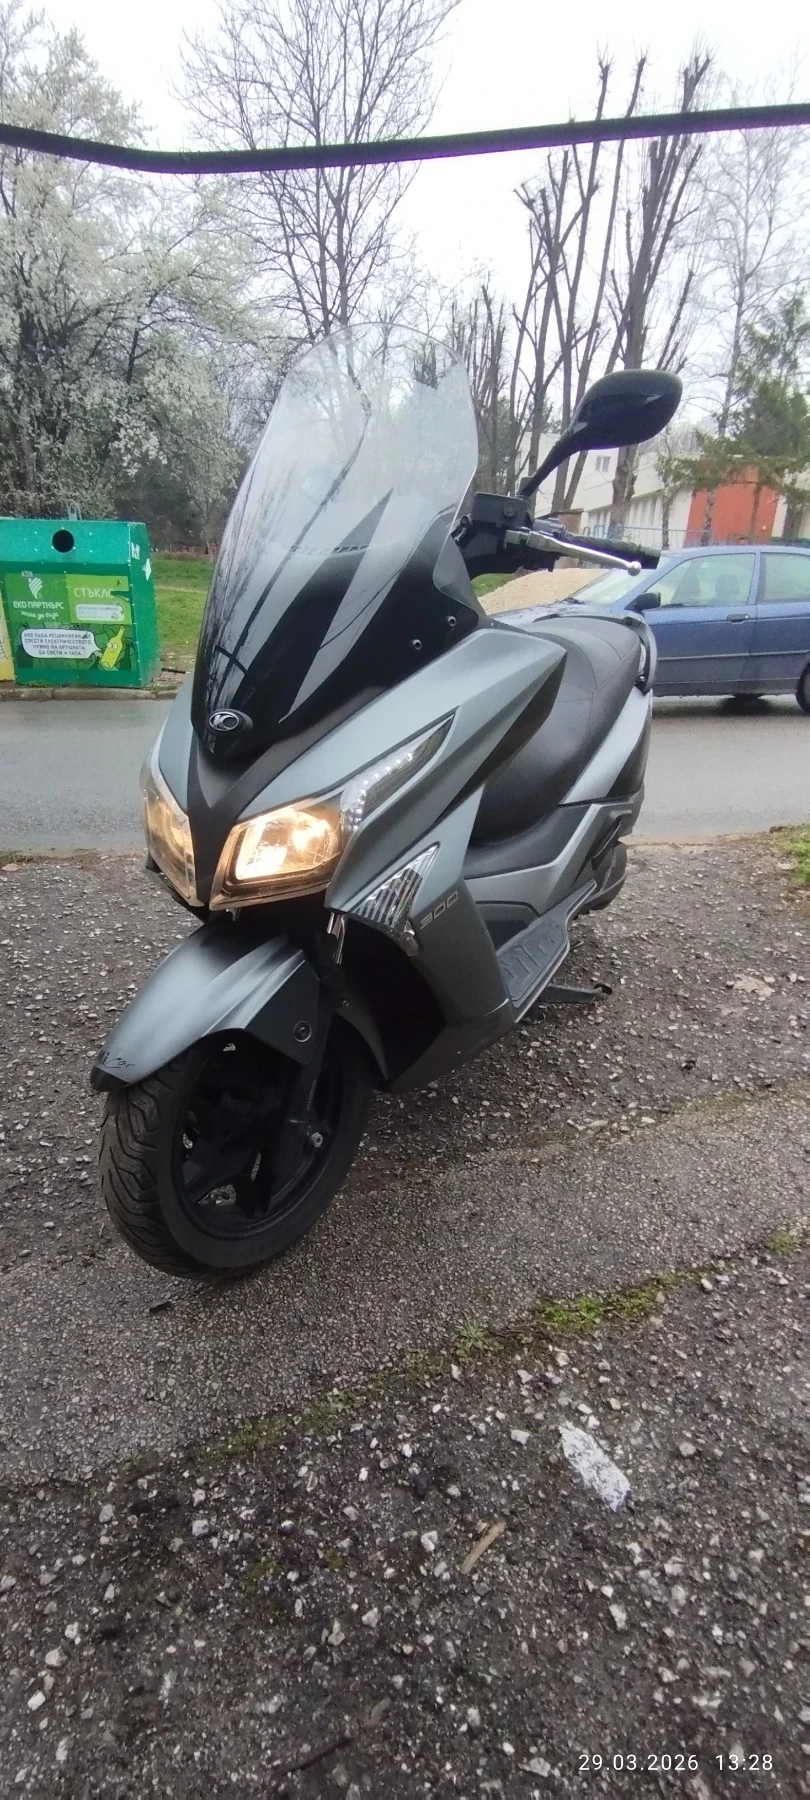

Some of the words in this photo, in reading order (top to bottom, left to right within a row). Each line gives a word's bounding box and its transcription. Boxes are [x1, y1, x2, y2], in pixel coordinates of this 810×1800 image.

[12, 600, 27, 609] ЕКО
[27, 601, 65, 609] ПАРТНЪРС
[419, 890, 459, 930] 300
